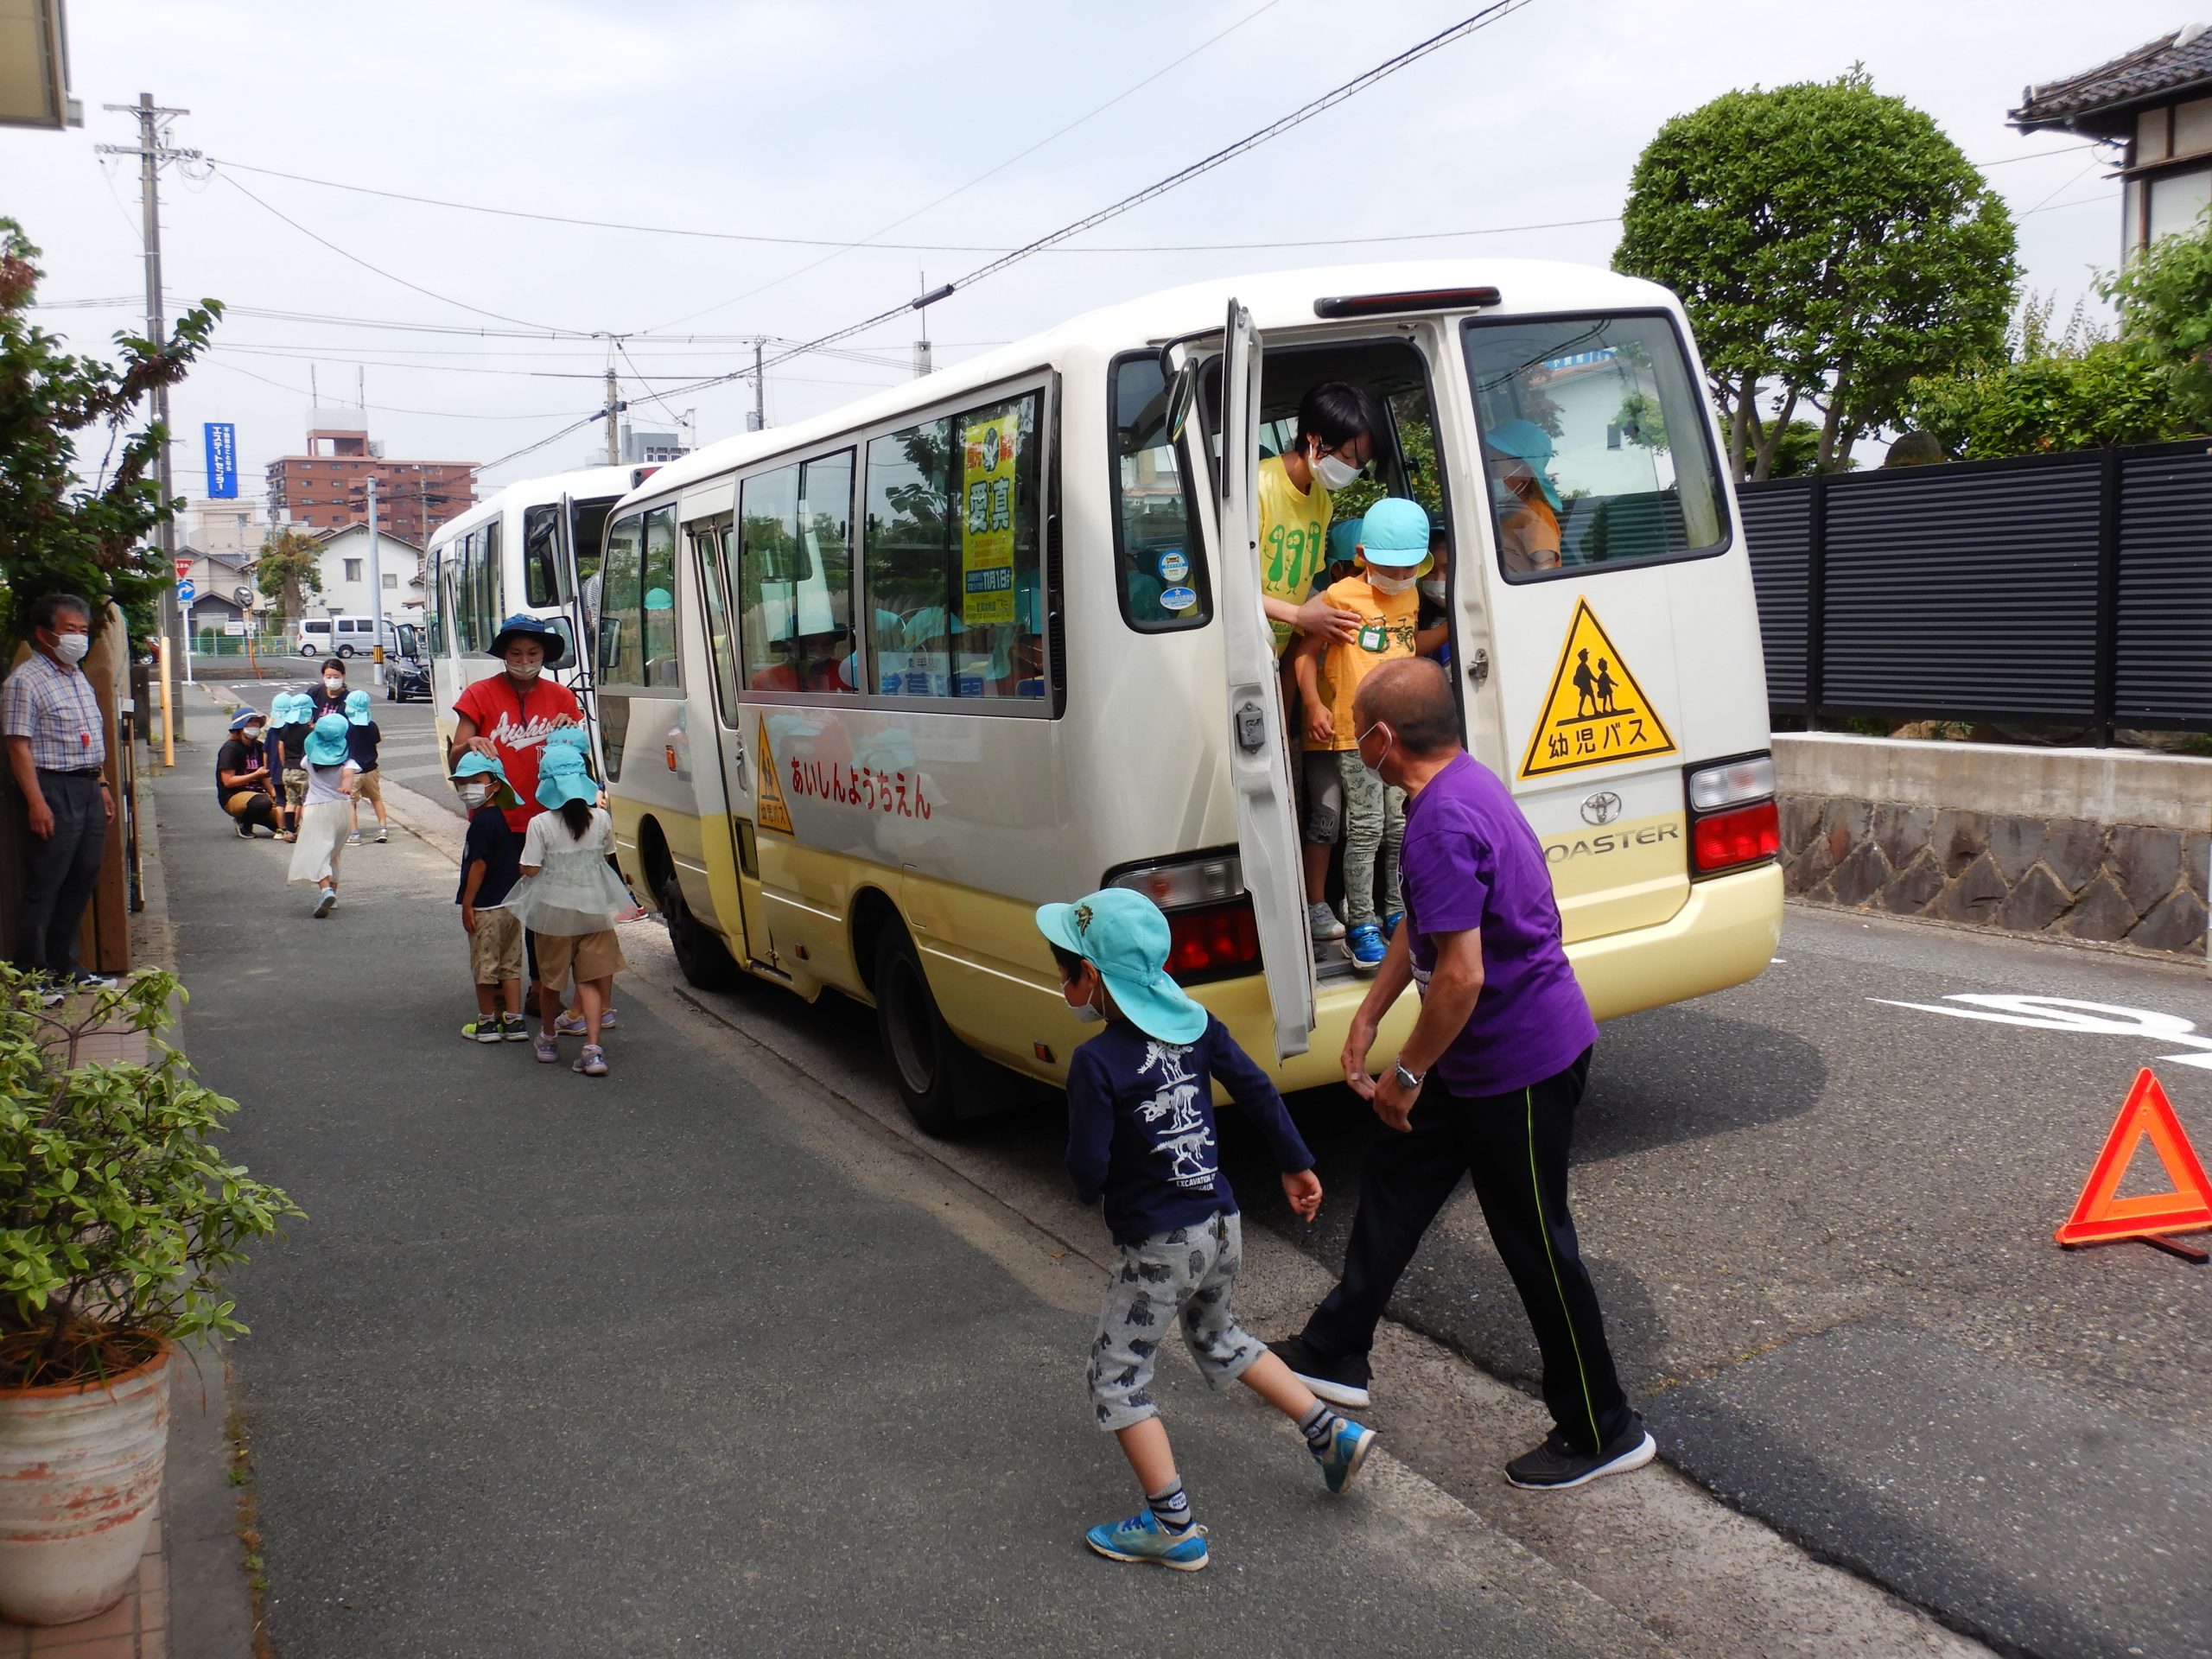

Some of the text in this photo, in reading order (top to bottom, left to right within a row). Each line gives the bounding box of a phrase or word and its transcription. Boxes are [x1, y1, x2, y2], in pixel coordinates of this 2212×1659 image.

[213, 426, 225, 491] エステートセンター
[969, 476, 1010, 536] 愛真
[1548, 719, 1647, 760] 幼児バス
[791, 755, 931, 821] あいしんようちえん
[1543, 823, 1680, 863] OASTER
